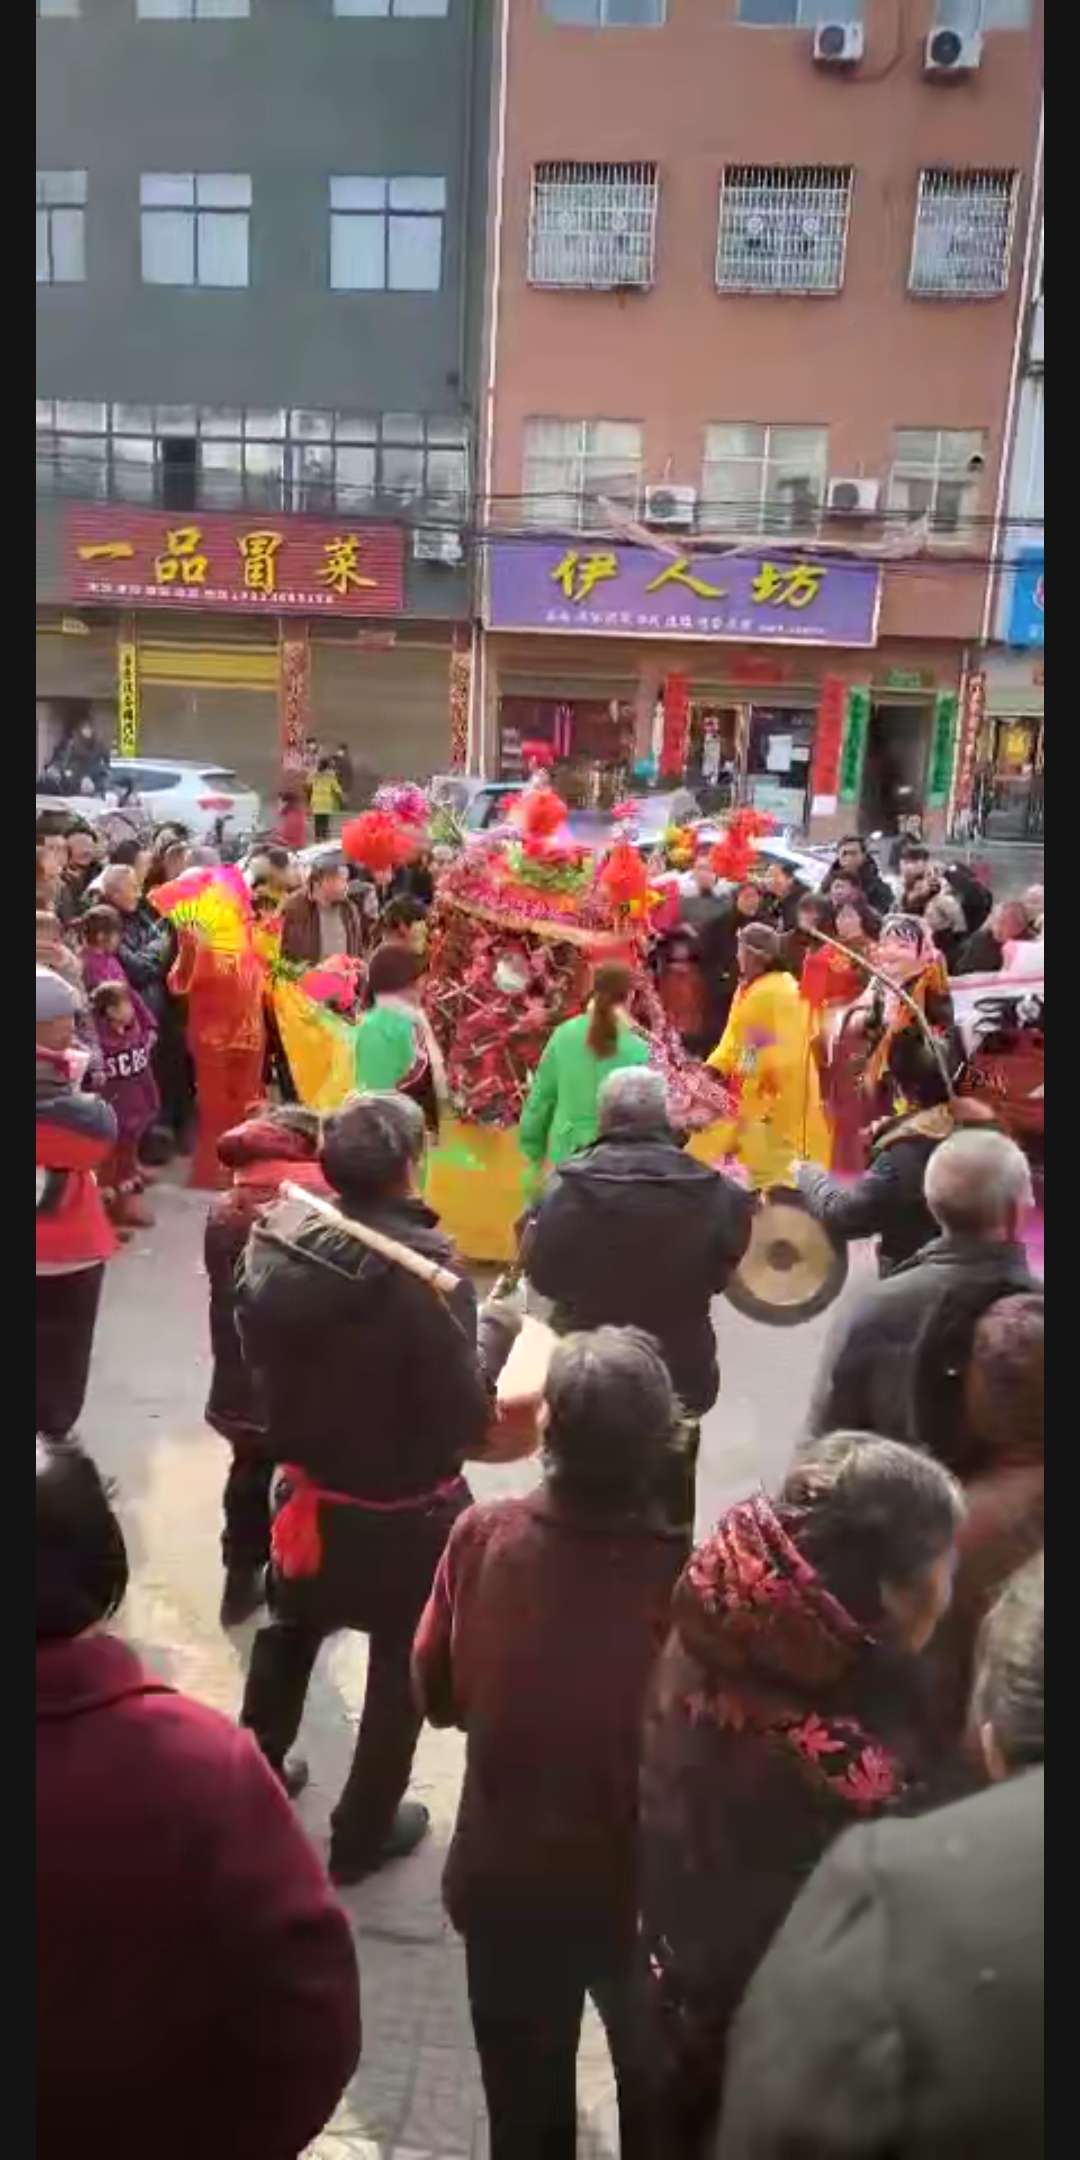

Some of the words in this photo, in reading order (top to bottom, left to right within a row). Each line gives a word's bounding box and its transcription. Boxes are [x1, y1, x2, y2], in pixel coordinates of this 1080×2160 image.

[78, 526, 377, 593] 一品冒菜
[550, 550, 826, 608] 伊人坊
